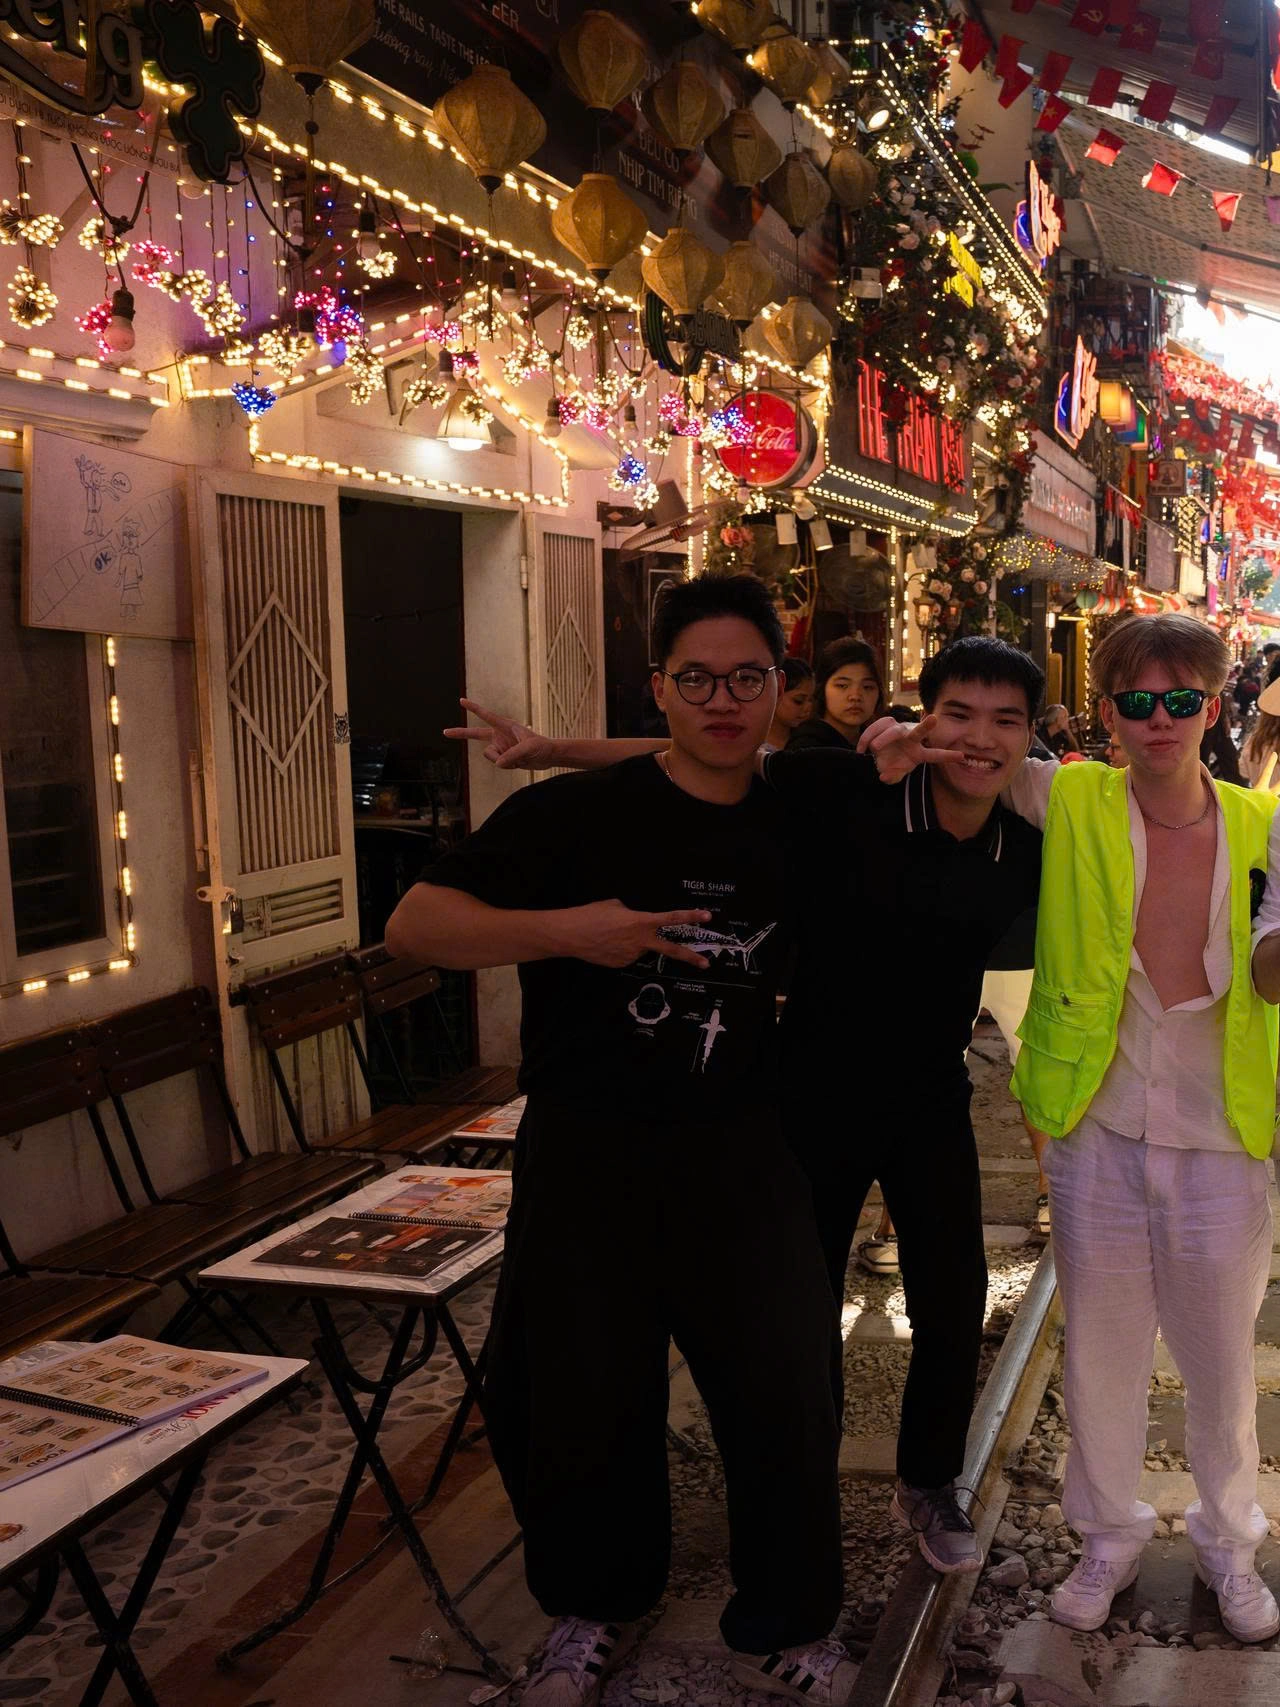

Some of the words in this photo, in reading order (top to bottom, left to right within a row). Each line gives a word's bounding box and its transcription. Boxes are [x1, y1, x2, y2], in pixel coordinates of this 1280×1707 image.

[683, 880, 705, 890] TIGER
[708, 882, 736, 893] SHARK
[177, 1384, 211, 1399] FOOD
[26, 1448, 67, 1468] FOOD
